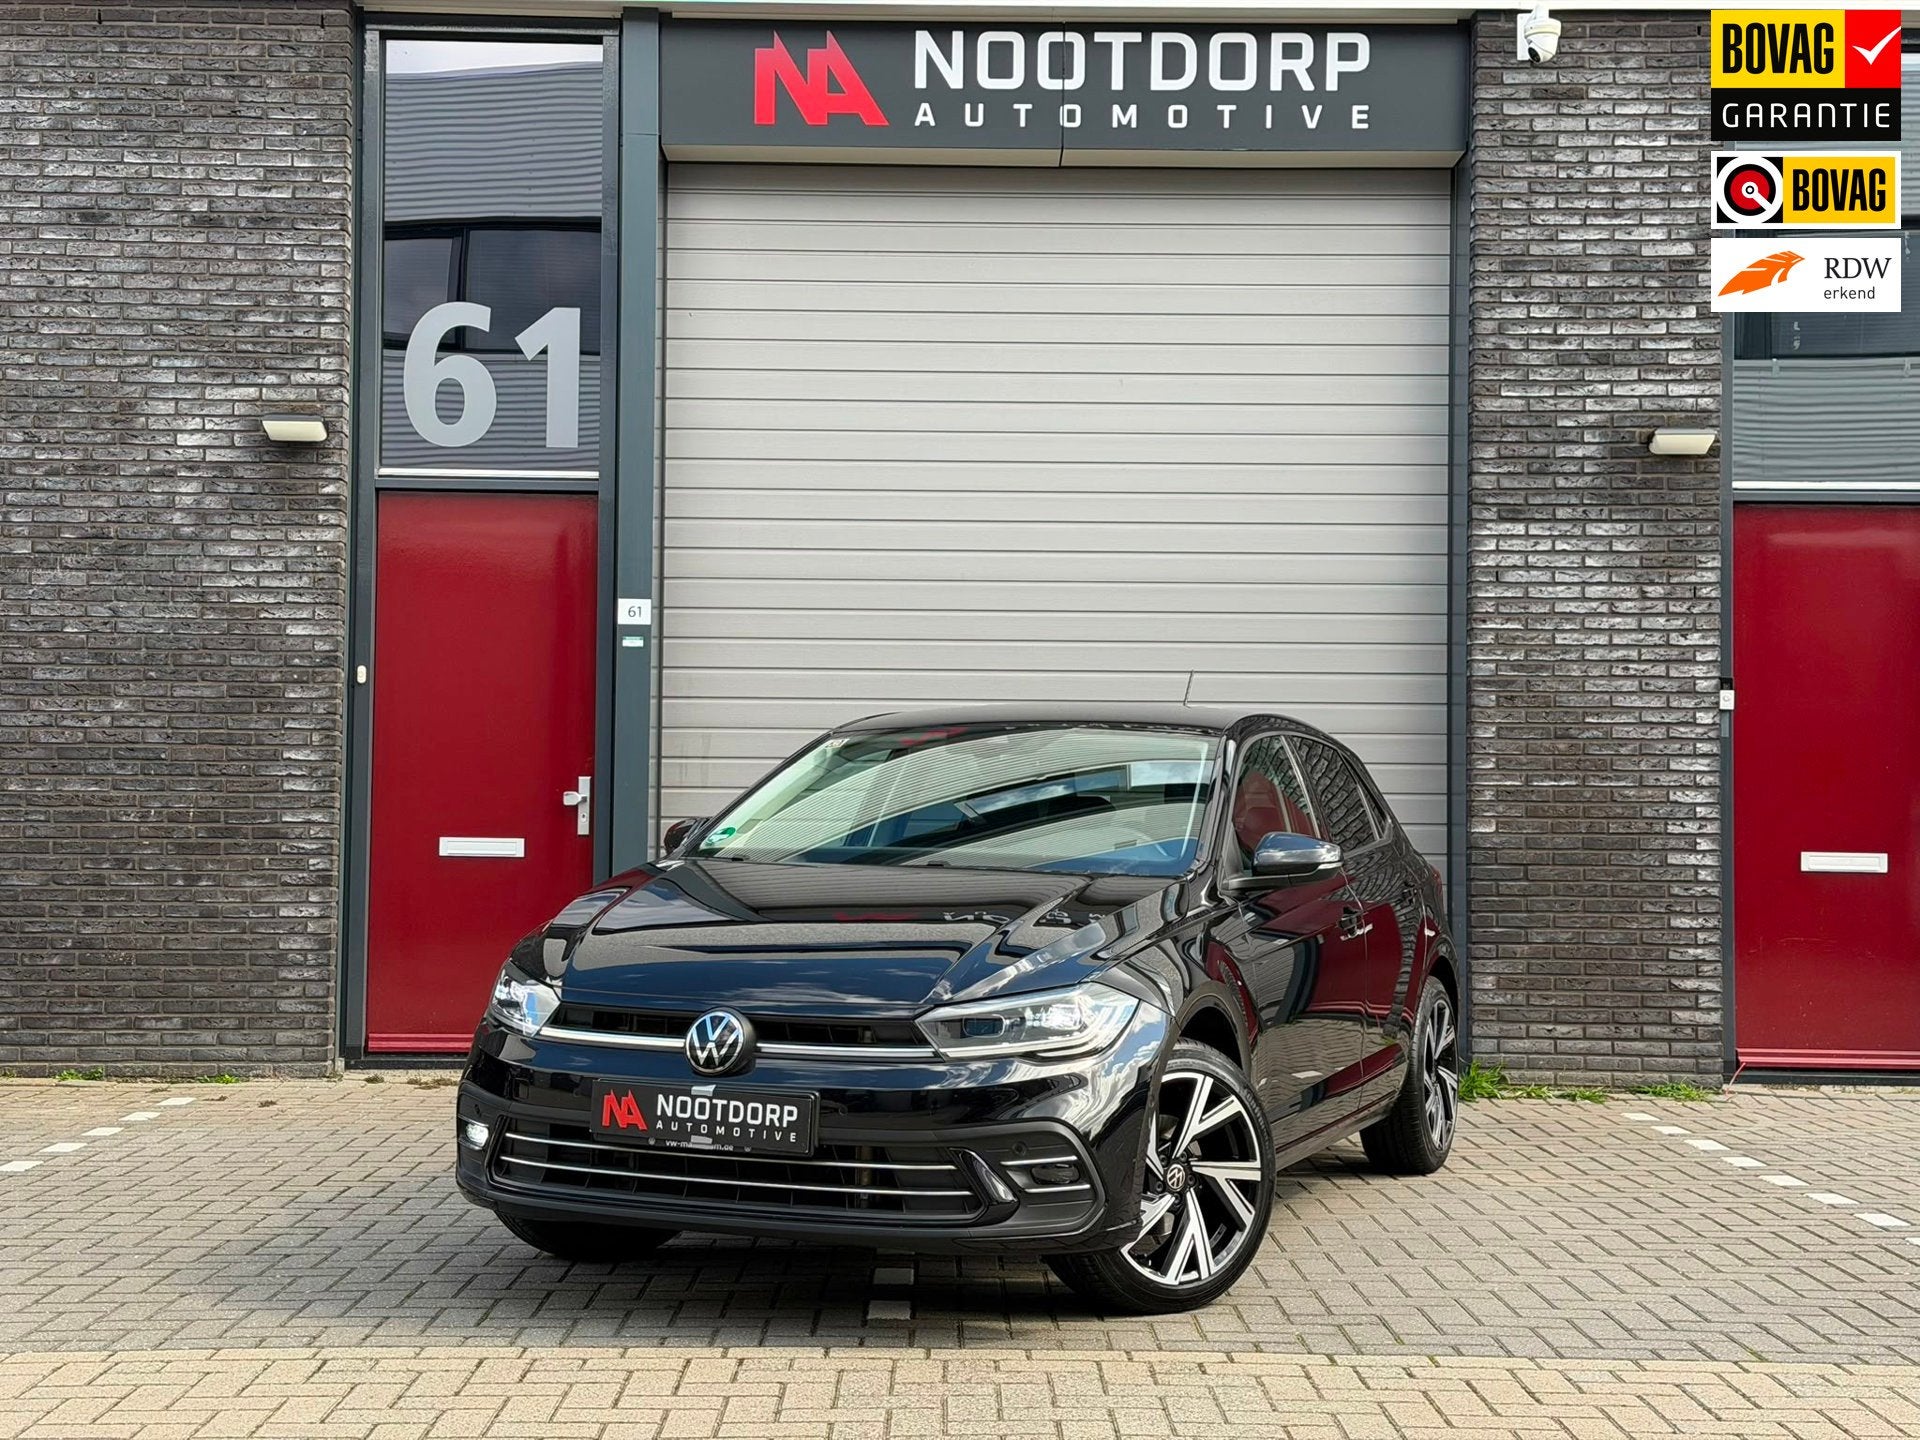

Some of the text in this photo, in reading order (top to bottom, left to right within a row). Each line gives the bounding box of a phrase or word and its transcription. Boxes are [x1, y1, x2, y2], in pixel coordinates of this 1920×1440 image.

[914, 30, 1369, 90] NOOTDORP
[914, 103, 1369, 129] AUTOMOTIVE
[403, 301, 580, 447] 61
[628, 606, 641, 617] 61
[656, 1093, 798, 1127] NOOTDORP
[656, 1120, 796, 1142] AUTOMOTIVE
